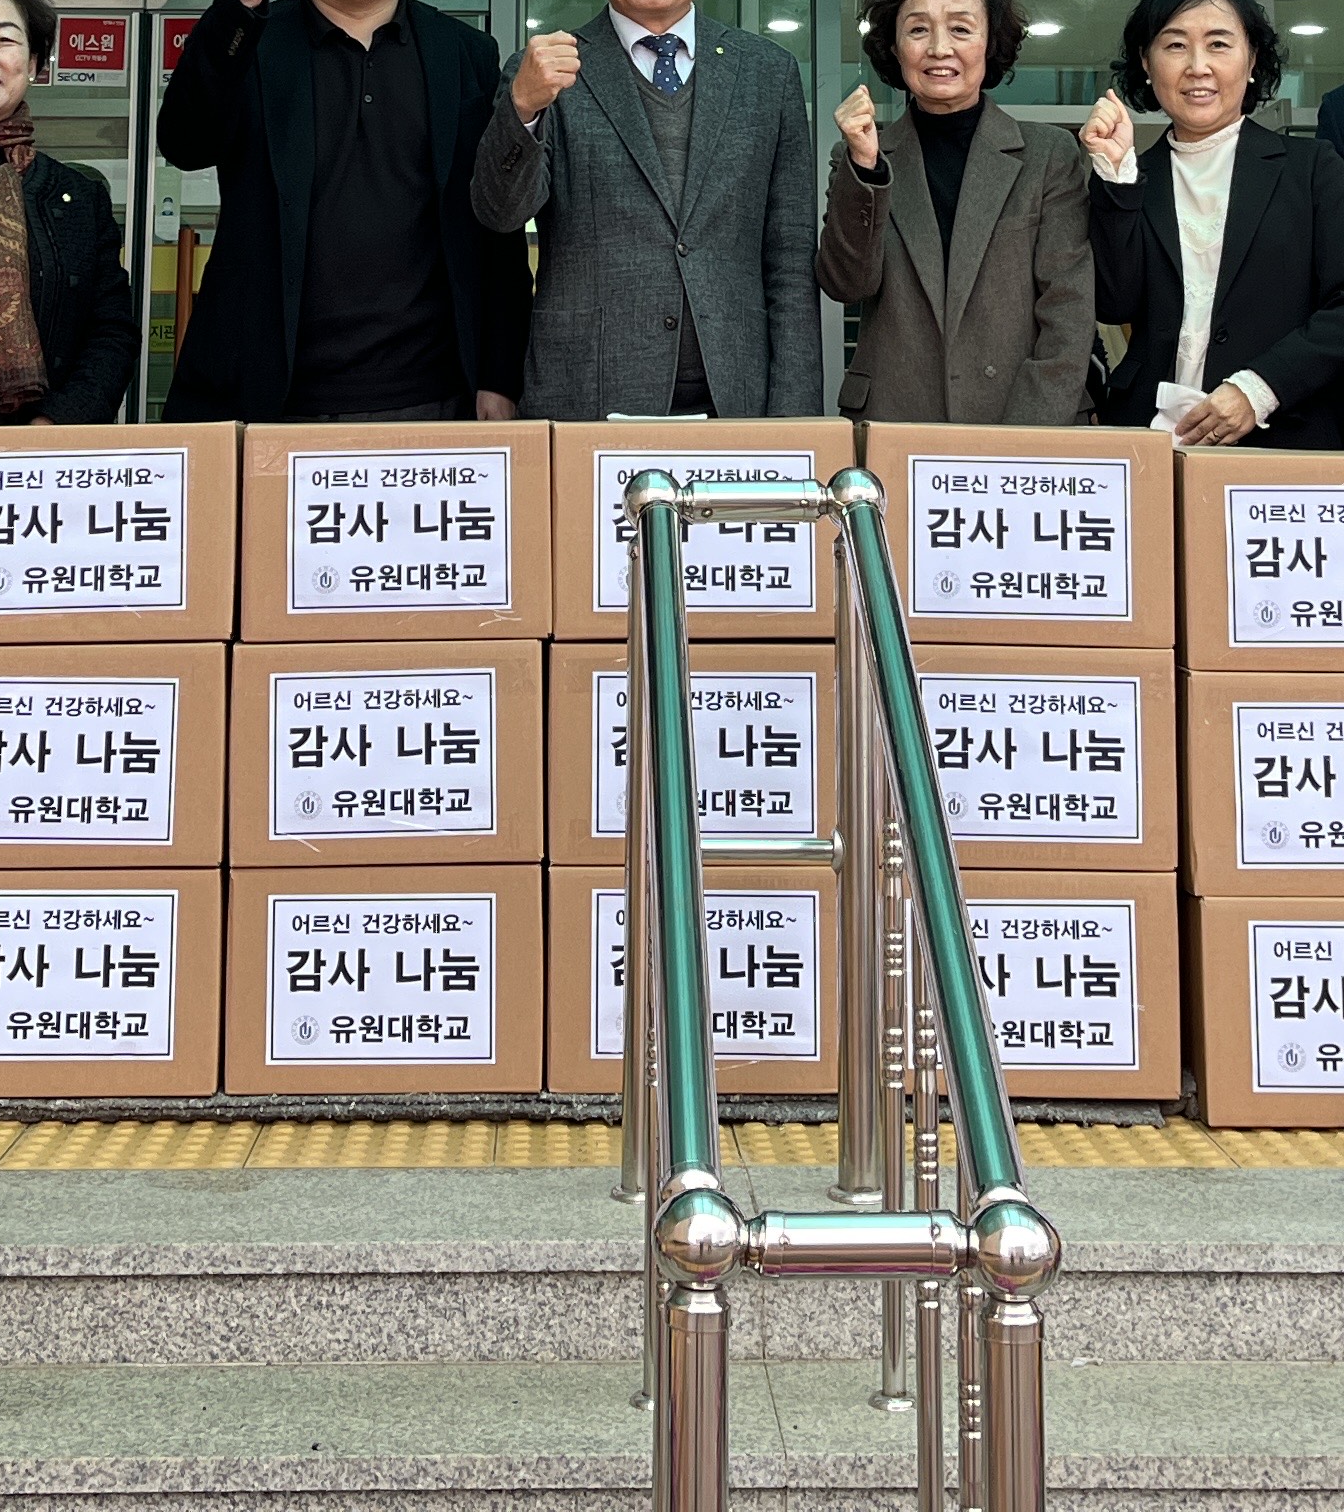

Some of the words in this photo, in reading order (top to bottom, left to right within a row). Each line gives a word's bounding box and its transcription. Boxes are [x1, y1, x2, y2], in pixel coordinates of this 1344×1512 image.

[69, 33, 115, 52] 에스원
[57, 72, 96, 84] SECOM
[55, 467, 165, 489] 건강하세요~
[312, 469, 368, 489] 어르신
[380, 466, 488, 488] 건강하세요~
[931, 474, 988, 494] 어르신
[1000, 475, 1108, 496] 건강하세요~
[88, 500, 171, 543] 나눔
[306, 501, 389, 544] 감사
[413, 500, 495, 542] 나눔
[1249, 503, 1306, 524] 어르신
[927, 507, 1009, 550] 감사
[1034, 509, 1115, 552] 나눔
[1246, 536, 1328, 578] 감사
[22, 564, 162, 594] 유원대학교
[349, 563, 487, 593] 유원대학교
[683, 564, 792, 592] 원대학교
[970, 571, 1108, 600] 유원대학교
[45, 696, 156, 718] 건강하세요~
[293, 690, 351, 712] 어르신
[363, 688, 473, 710] 건강하세요~
[939, 692, 996, 713] 어르신
[1008, 693, 1118, 716] 건강하세요~
[288, 724, 372, 769] 감사
[397, 722, 481, 765] 나눔
[719, 724, 801, 767] 나눔
[1257, 721, 1314, 742] 어르신
[76, 730, 161, 774] 나눔
[933, 726, 1017, 770] 감사
[1042, 728, 1126, 772] 나눔
[1253, 755, 1337, 798] 감사
[8, 795, 150, 825] 유원대학교
[331, 787, 473, 818] 유원대학교
[977, 792, 1118, 822] 유원대학교
[42, 909, 155, 931] 건강하세요~
[292, 913, 350, 935] 어르신
[362, 913, 473, 935] 건강하세요~
[706, 909, 797, 930] 강하세요~
[1001, 919, 1113, 940] 건강하세요~
[1273, 940, 1332, 961] 어르신
[74, 944, 160, 988] 나눔
[285, 948, 371, 993] 감사
[395, 948, 480, 992] 나눔
[720, 944, 804, 988] 나눔
[1036, 953, 1121, 997] 나눔
[6, 1011, 149, 1040] 유원대학교
[329, 1014, 471, 1044] 유원대학교
[712, 1010, 796, 1039] 대학교
[991, 1020, 1114, 1049] 원대학교
